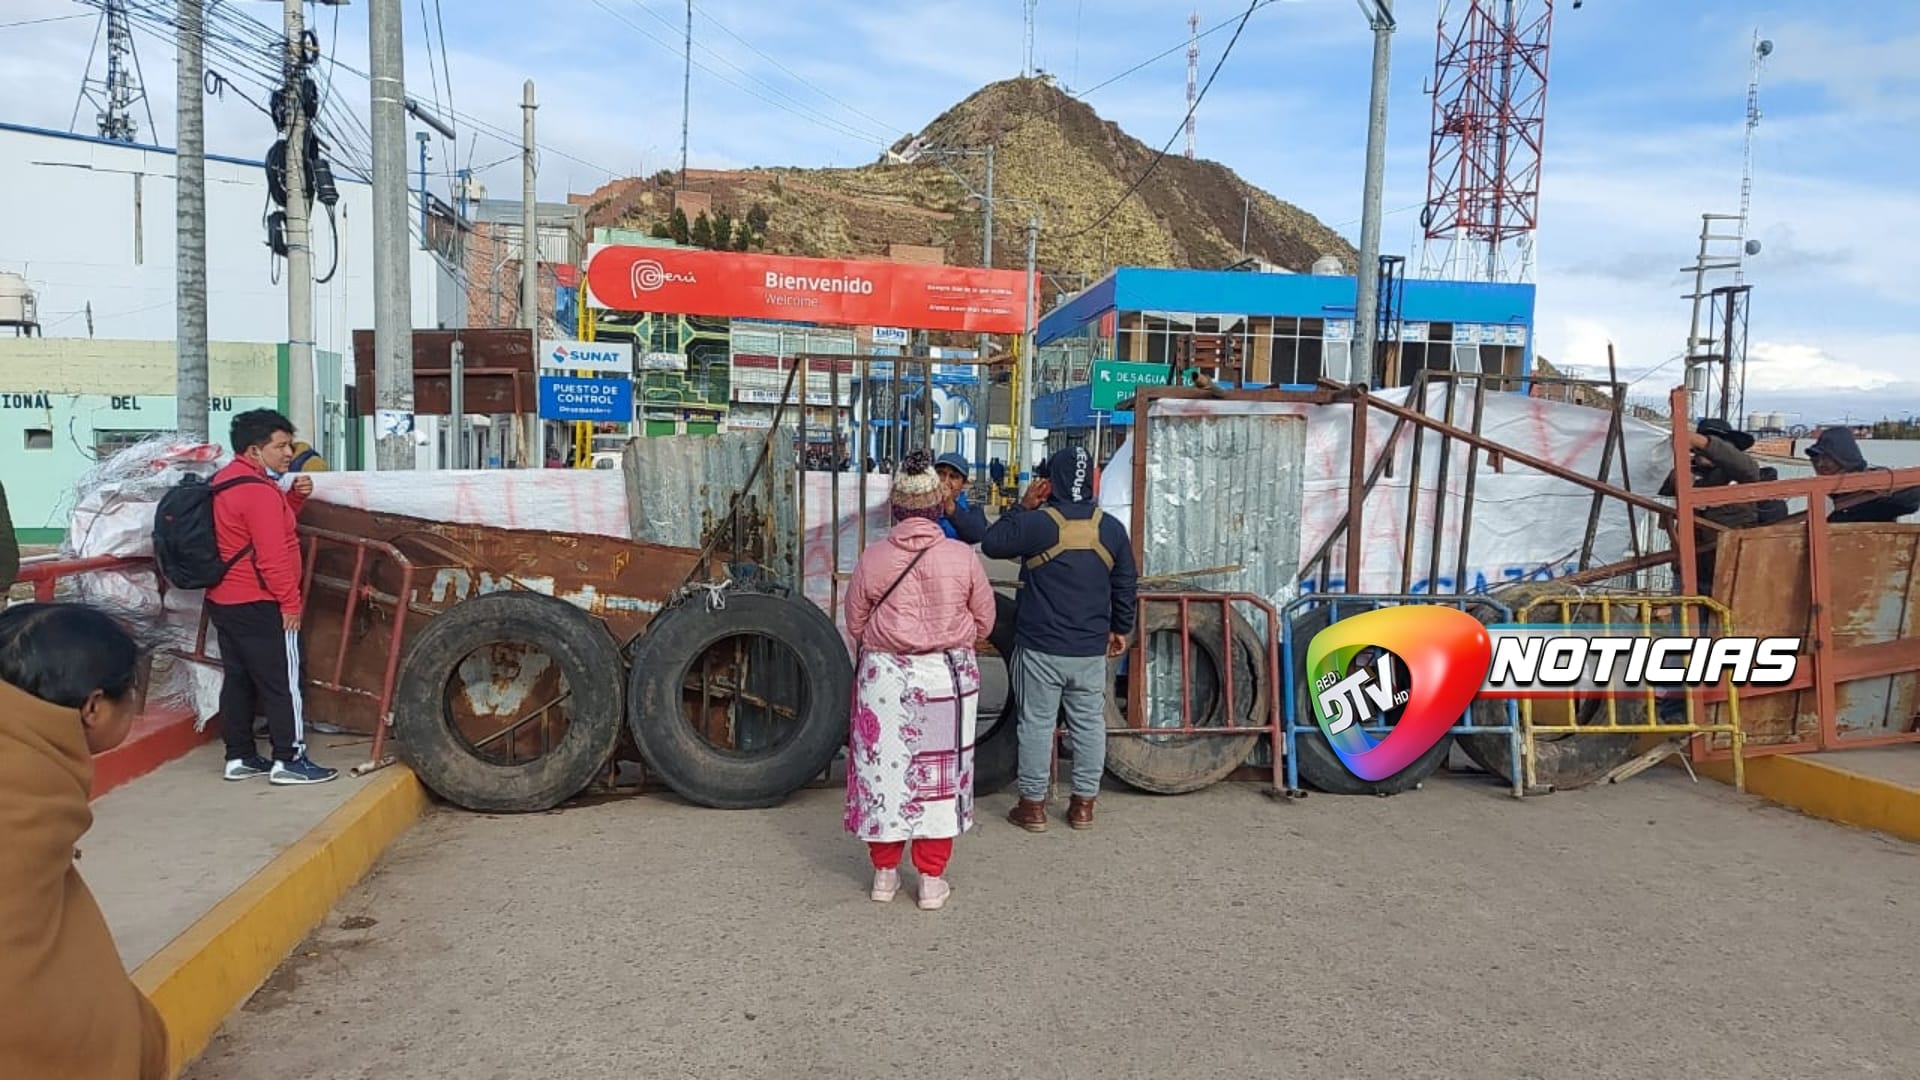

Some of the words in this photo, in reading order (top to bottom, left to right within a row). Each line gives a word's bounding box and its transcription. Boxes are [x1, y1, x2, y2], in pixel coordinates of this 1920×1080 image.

[765, 271, 873, 294] Bienvenido
[764, 293, 818, 307] Welcome
[570, 350, 620, 362] SUNAT
[1116, 371, 1195, 387] DESAGUARO
[553, 383, 600, 395] PUESTO
[602, 385, 619, 396] DE
[1, 394, 54, 409] IONAL
[111, 396, 141, 411] DEL
[557, 393, 615, 405] CONTROL
